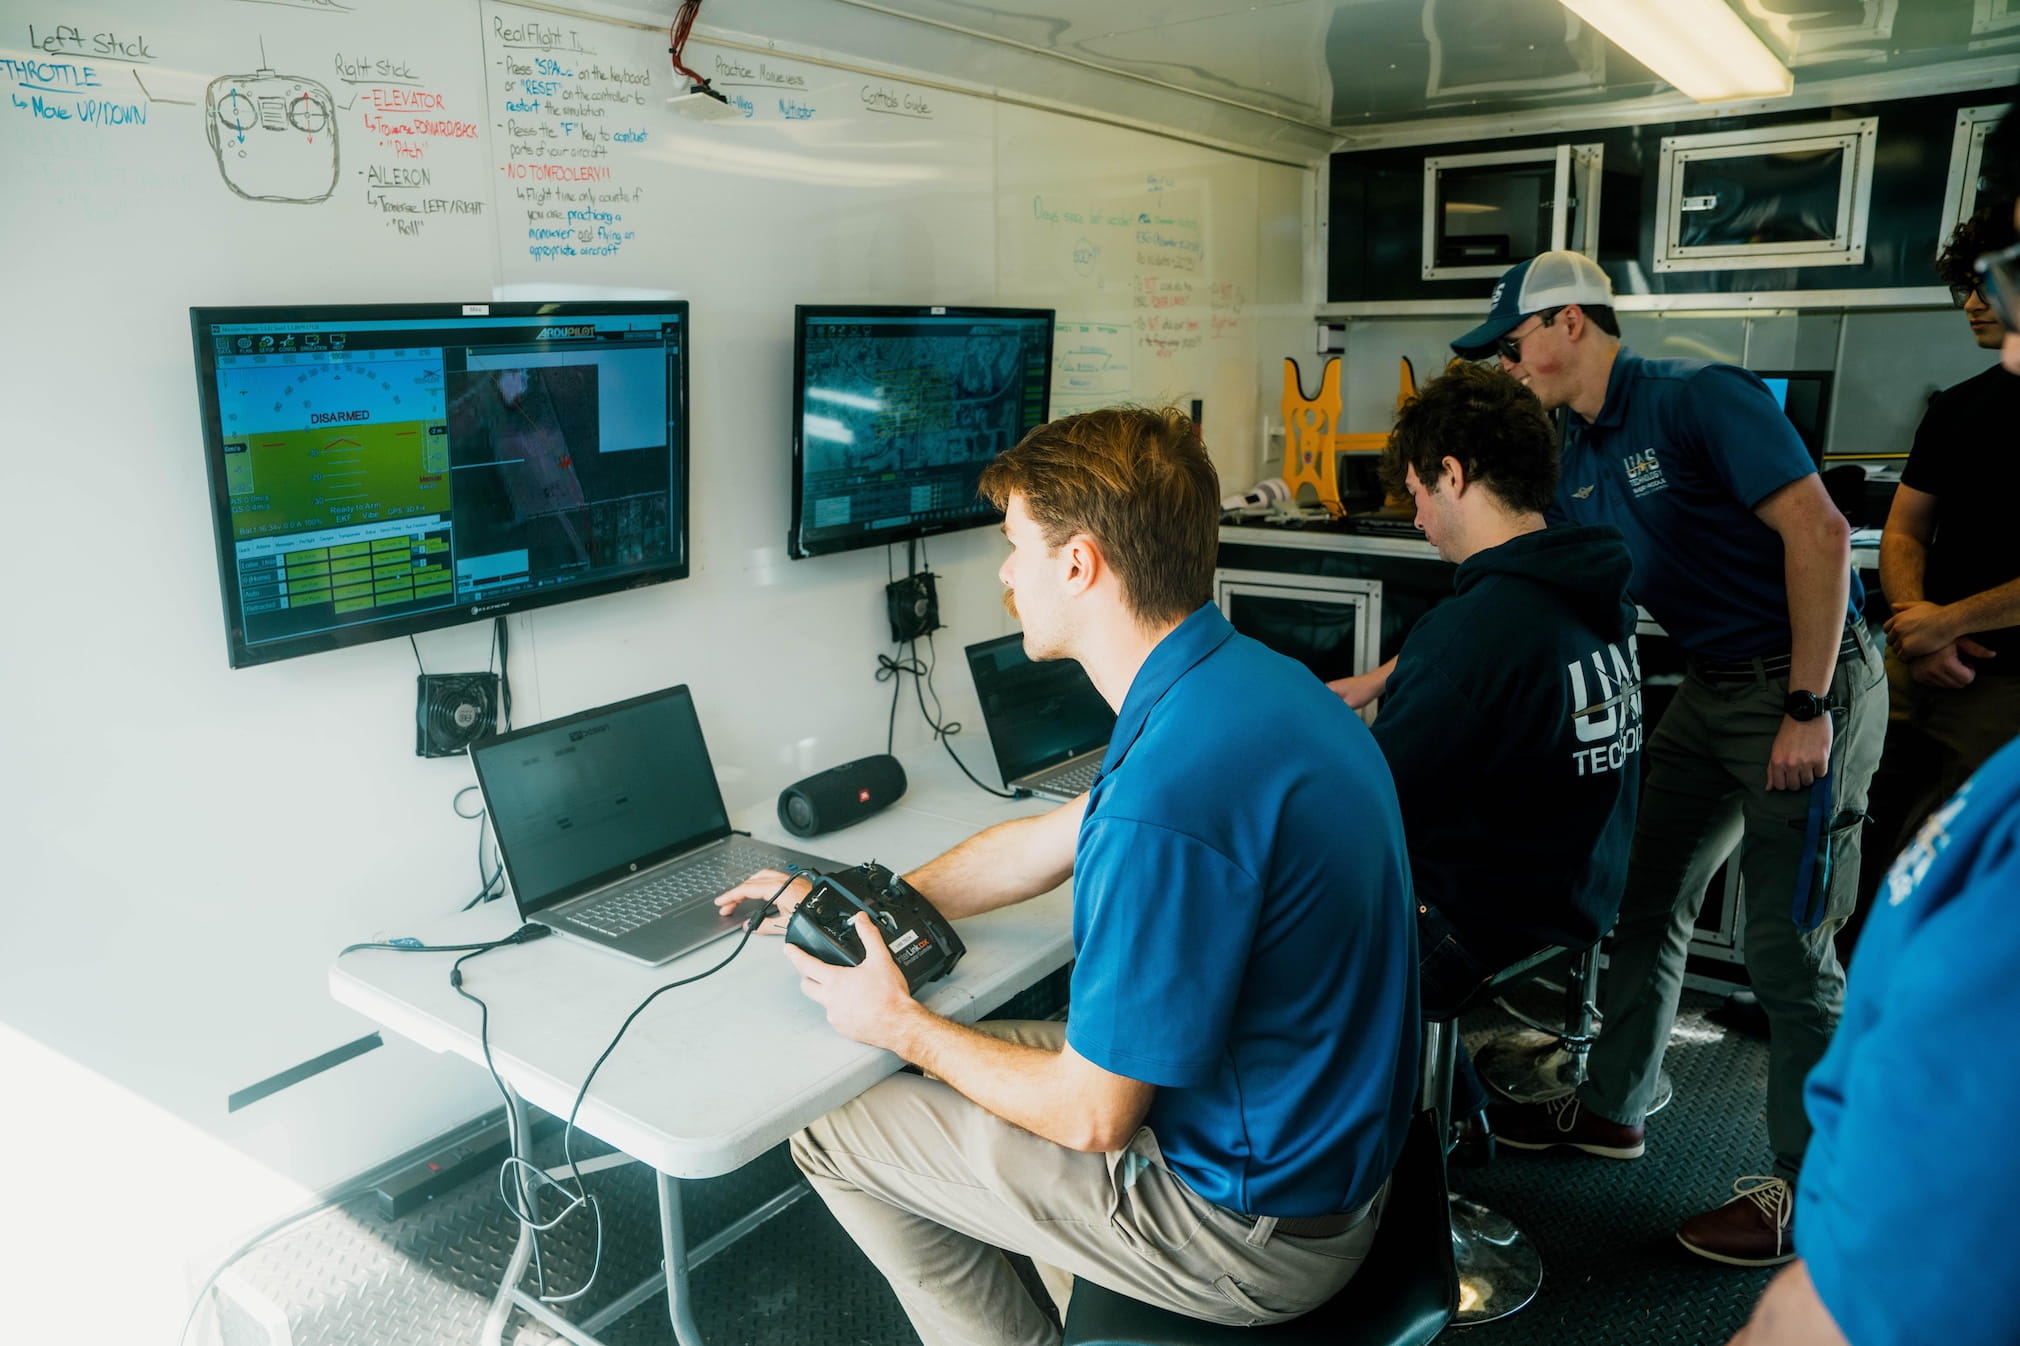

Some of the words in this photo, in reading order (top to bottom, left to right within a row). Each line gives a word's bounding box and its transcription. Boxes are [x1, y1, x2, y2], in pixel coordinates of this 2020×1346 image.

[29, 24, 86, 53] Left
[94, 33, 157, 59] Stick
[335, 53, 372, 82] Right
[376, 55, 419, 79] Stick
[506, 55, 533, 76] Press
[578, 69, 590, 81] on
[592, 66, 608, 81] the
[610, 68, 650, 88] keyboard
[715, 54, 755, 79] Practice
[372, 89, 446, 110] ELEVATOR
[505, 80, 515, 92] or
[562, 90, 574, 100] on
[575, 86, 590, 101] the
[633, 90, 646, 105] to
[31, 96, 73, 120] Move
[77, 102, 148, 128] UP/DOWN
[506, 99, 540, 113] restart
[544, 103, 561, 116] the
[508, 118, 537, 138] Press
[539, 122, 557, 138] the
[581, 123, 597, 143] key
[599, 130, 611, 142] to
[536, 141, 546, 158] of
[368, 165, 431, 185] AILERON
[507, 163, 527, 180] NO
[526, 187, 552, 206] Flight
[555, 187, 576, 202] time
[423, 199, 487, 215] LEFT/RIGHT
[527, 209, 544, 226] you
[546, 210, 565, 220] are
[615, 213, 622, 222] a
[578, 226, 593, 242] and
[536, 326, 595, 340] ARDUPILOT
[311, 410, 370, 424] DISARMED
[1624, 447, 1660, 479] UAS
[330, 505, 354, 515] Ready
[356, 503, 364, 511] to
[366, 502, 381, 510] Arm
[336, 514, 352, 523] EKF
